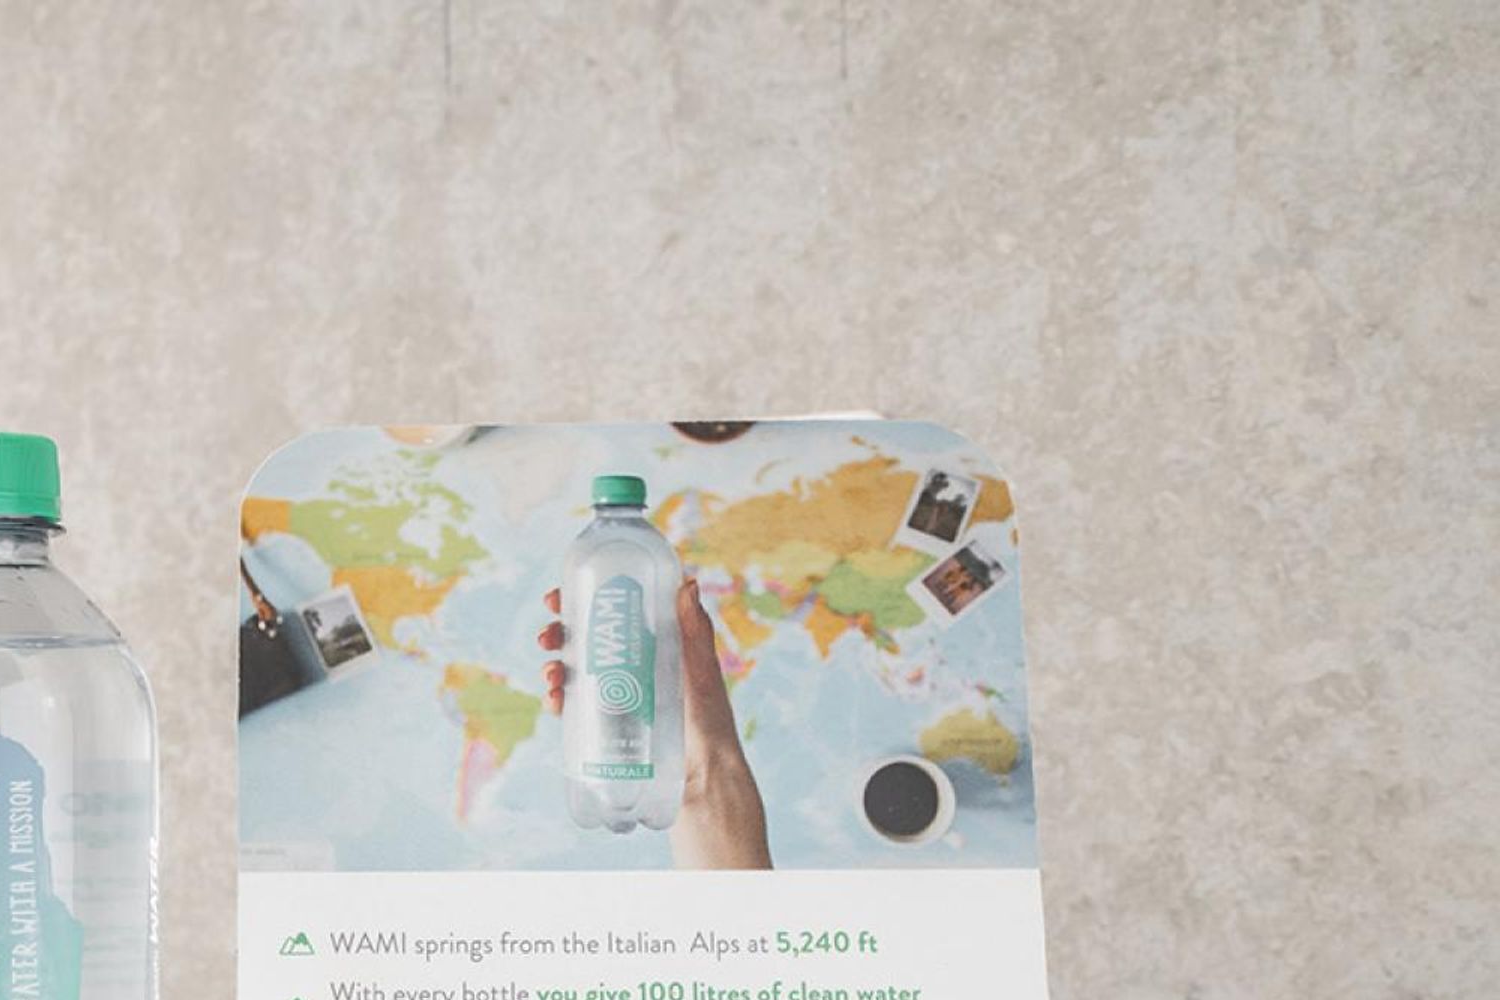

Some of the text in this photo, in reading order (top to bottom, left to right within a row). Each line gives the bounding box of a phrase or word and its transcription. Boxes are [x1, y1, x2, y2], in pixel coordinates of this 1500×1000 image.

[595, 588, 626, 667] WAMI
[586, 766, 650, 777] TURALE
[8, 780, 34, 855] MISSION
[11, 860, 35, 874] A
[9, 876, 39, 937] WITH
[329, 930, 878, 963] WAMI springs from the Italian Alps at 5,240 ft
